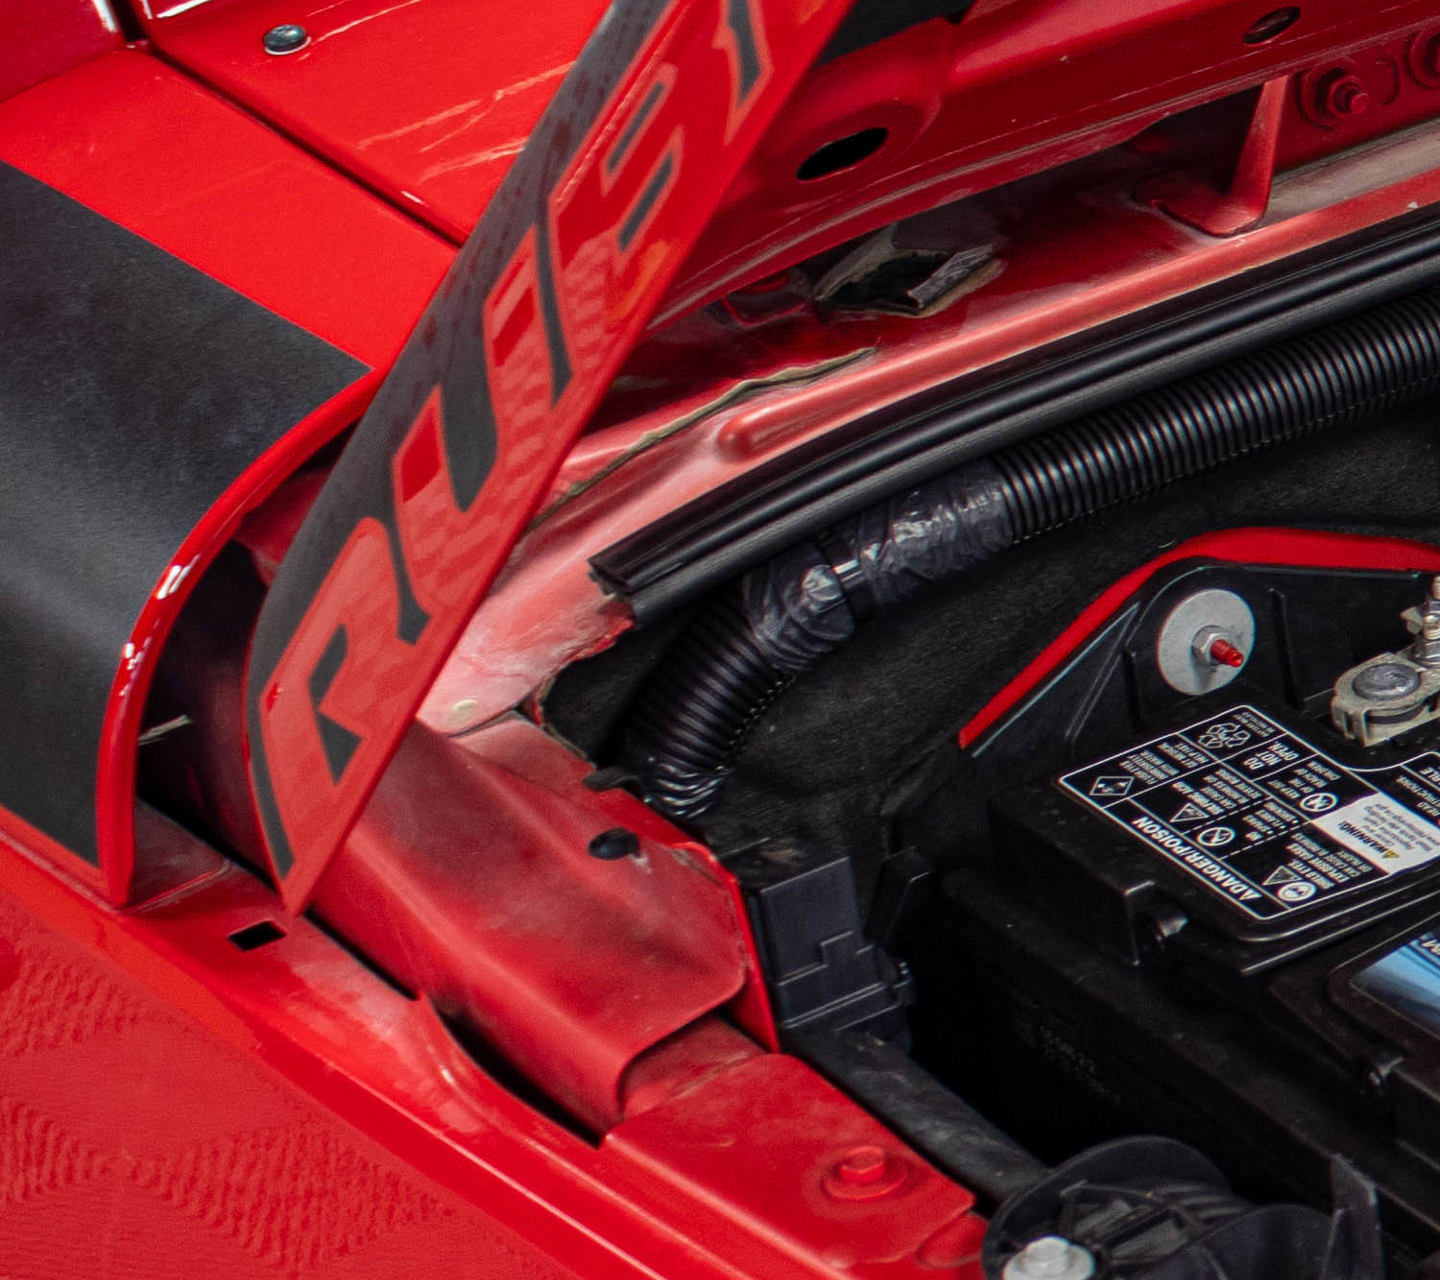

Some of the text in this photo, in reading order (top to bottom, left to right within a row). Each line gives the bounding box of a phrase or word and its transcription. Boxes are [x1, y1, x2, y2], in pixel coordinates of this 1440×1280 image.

[1253, 748, 1284, 765] NOT
[1265, 740, 1303, 761] OPEN.
[1241, 756, 1266, 770] DO
[1334, 821, 1389, 853] WARNING:
[1129, 816, 1252, 894] DANGER/POISON
